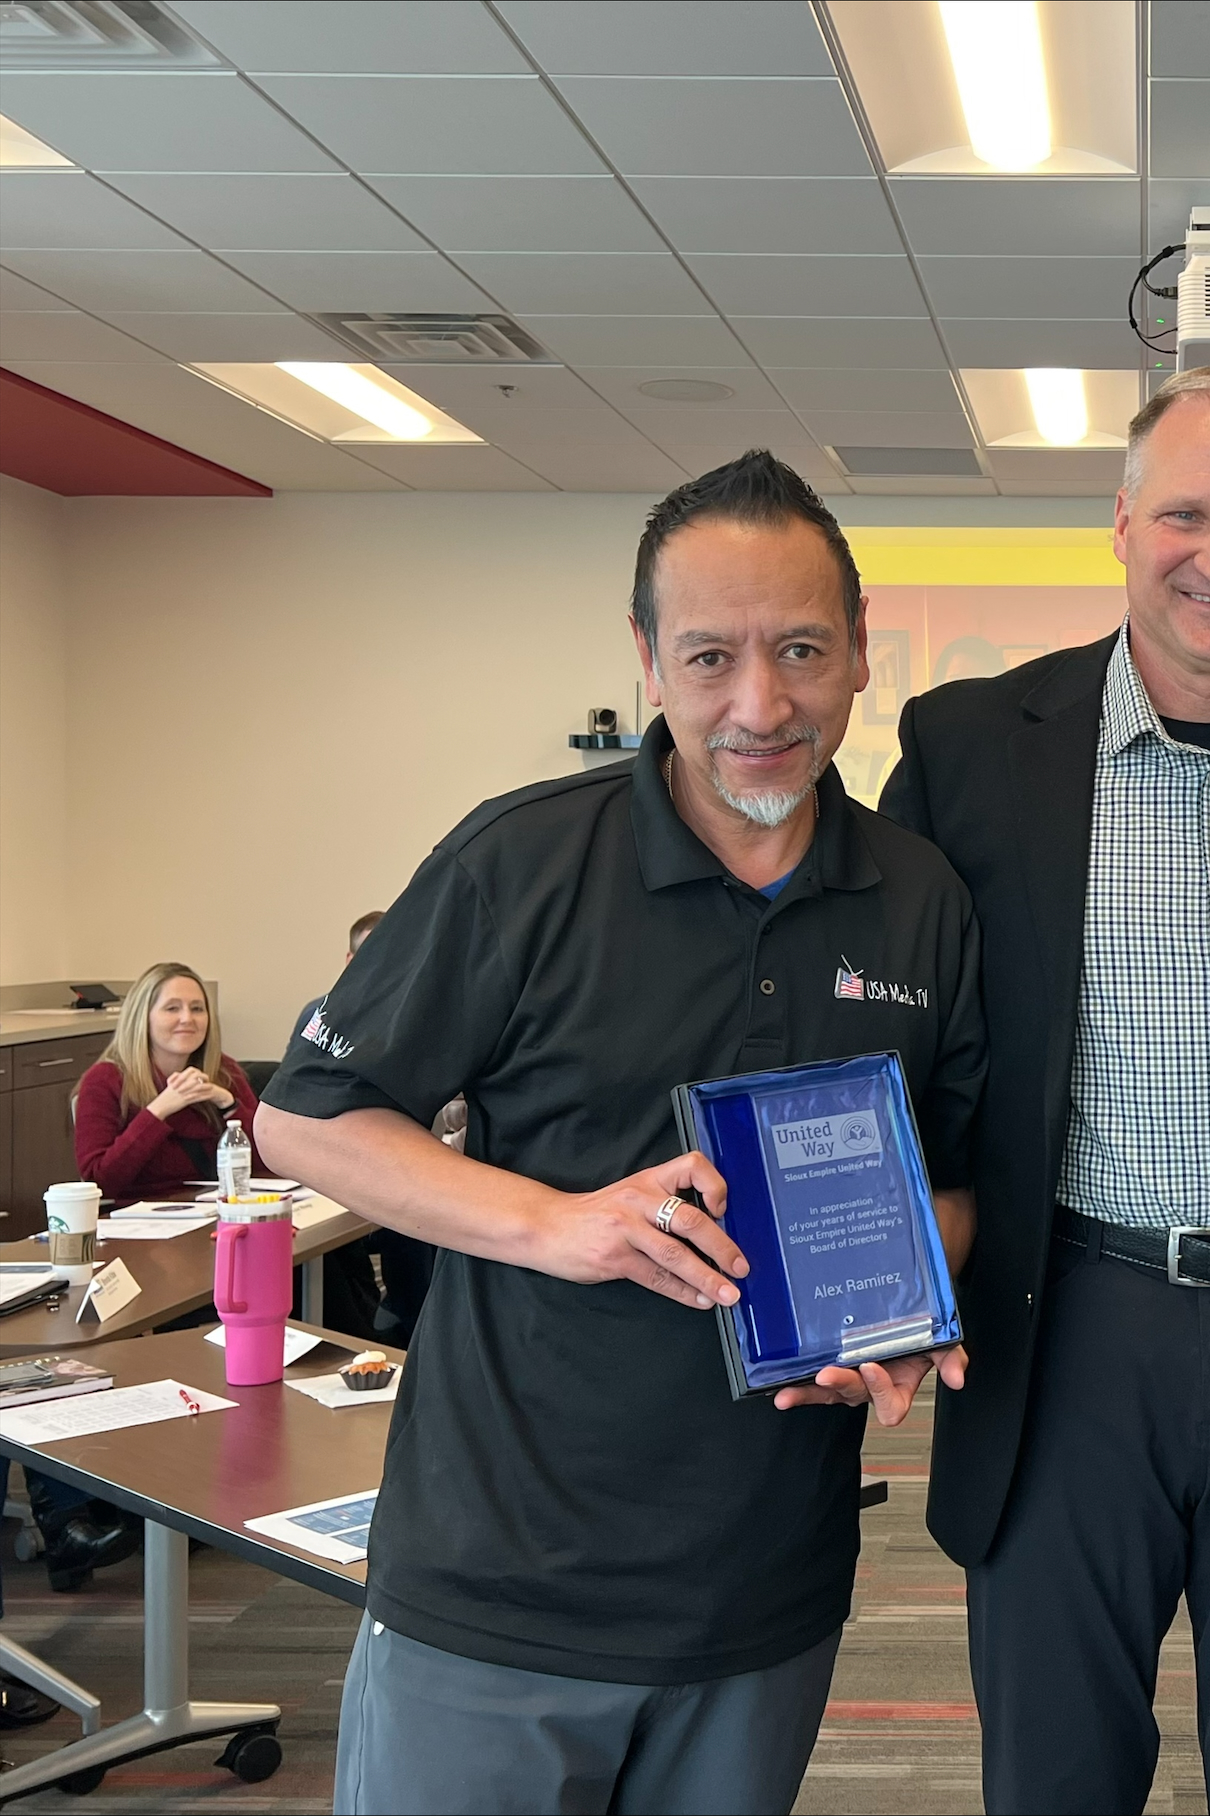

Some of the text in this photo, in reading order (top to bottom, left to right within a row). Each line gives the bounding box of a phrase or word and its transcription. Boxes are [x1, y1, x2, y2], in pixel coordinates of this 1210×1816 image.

[866, 980, 888, 1002] USA
[916, 988, 928, 1009] TV
[776, 1121, 833, 1145] United
[801, 1141, 835, 1158] Way
[784, 1159, 882, 1183] Sioux Empire United Way
[788, 1204, 898, 1232] of your years of service to
[809, 1198, 874, 1215] In appreciation
[789, 1216, 903, 1245] Sioux Empire United Way's
[810, 1232, 888, 1254] Board of Directors
[814, 1272, 902, 1300] Alex Ramirez
